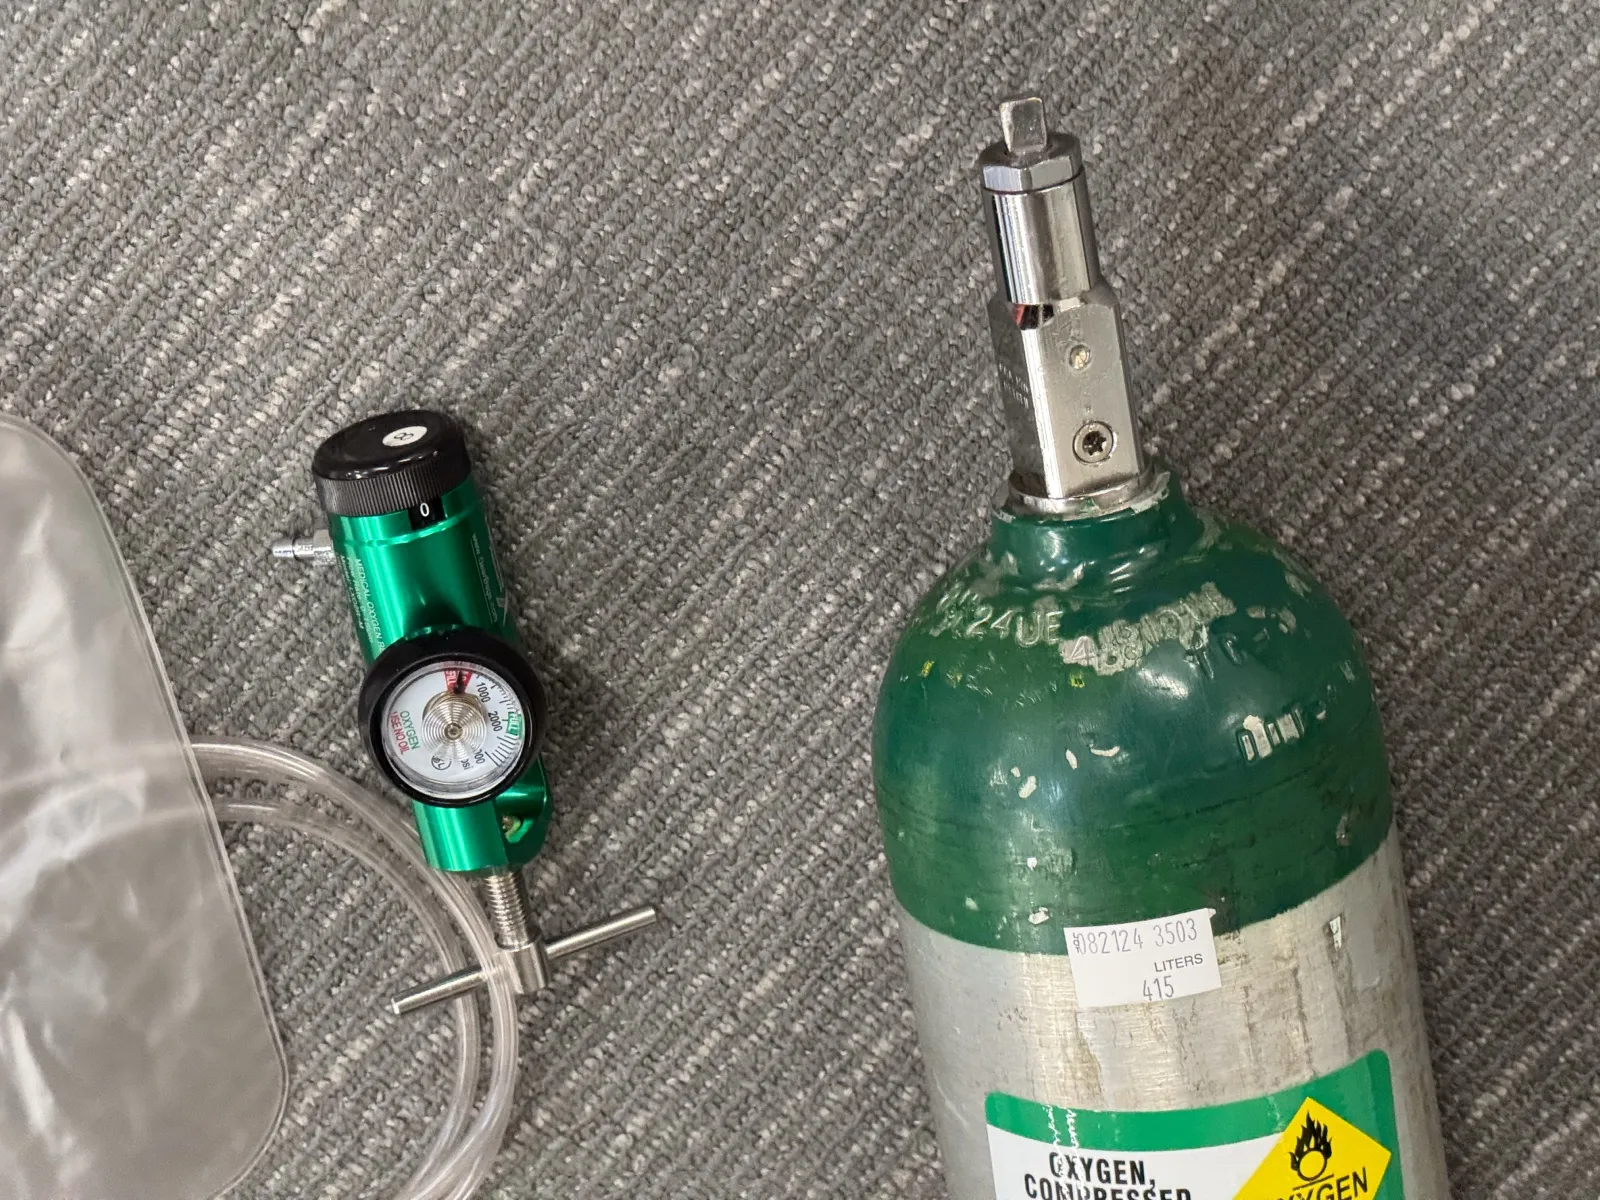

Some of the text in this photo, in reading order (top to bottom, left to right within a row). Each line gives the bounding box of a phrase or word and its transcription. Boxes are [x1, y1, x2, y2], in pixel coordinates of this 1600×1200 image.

[420, 503, 429, 517] 0
[355, 558, 371, 598] MEDICAL
[366, 601, 382, 639] OXYGEN
[476, 682, 491, 702] 1000
[399, 711, 420, 750] OXYGEN
[488, 710, 503, 732] 2000
[394, 727, 405, 740] NO
[398, 740, 409, 755] OIL
[1153, 918, 1198, 947] 3503
[1154, 953, 1204, 973] LITERS
[1143, 975, 1174, 1000] 415
[1050, 1151, 1156, 1190] OXYGEN,
[1276, 1166, 1368, 1200] GEN
